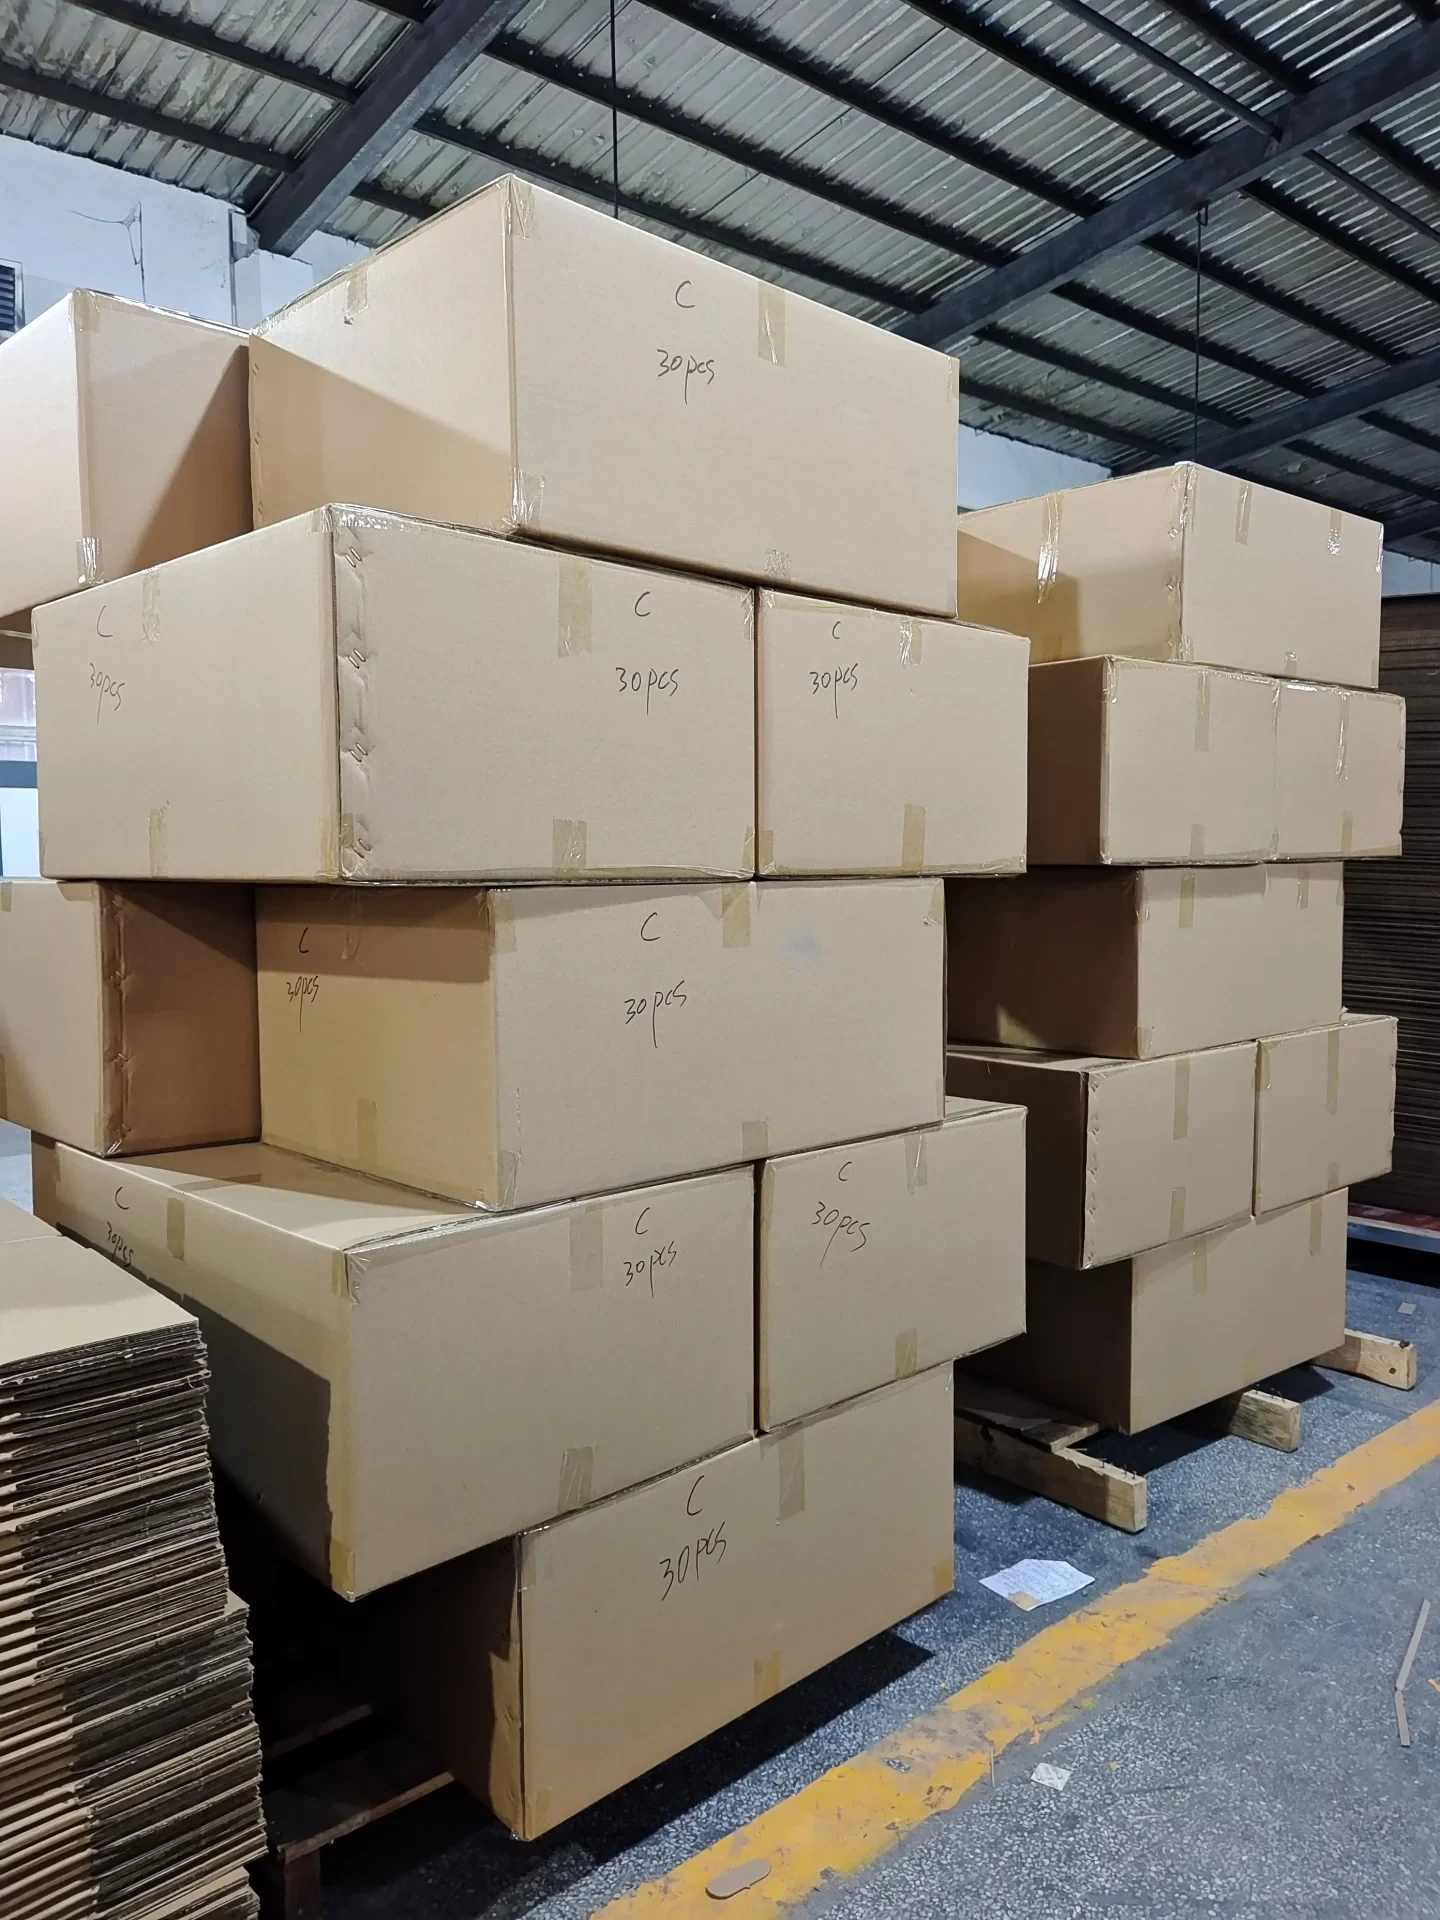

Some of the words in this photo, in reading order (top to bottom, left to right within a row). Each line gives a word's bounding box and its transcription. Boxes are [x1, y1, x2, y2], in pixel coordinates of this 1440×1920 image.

[675, 280, 696, 308] C
[635, 591, 651, 617] C
[97, 604, 113, 638] C
[831, 621, 841, 639] C
[298, 926, 310, 954] C
[641, 912, 661, 941] C
[838, 1161, 853, 1181] C
[115, 1186, 130, 1210] C
[635, 1207, 650, 1235] C
[687, 1475, 705, 1516] C
